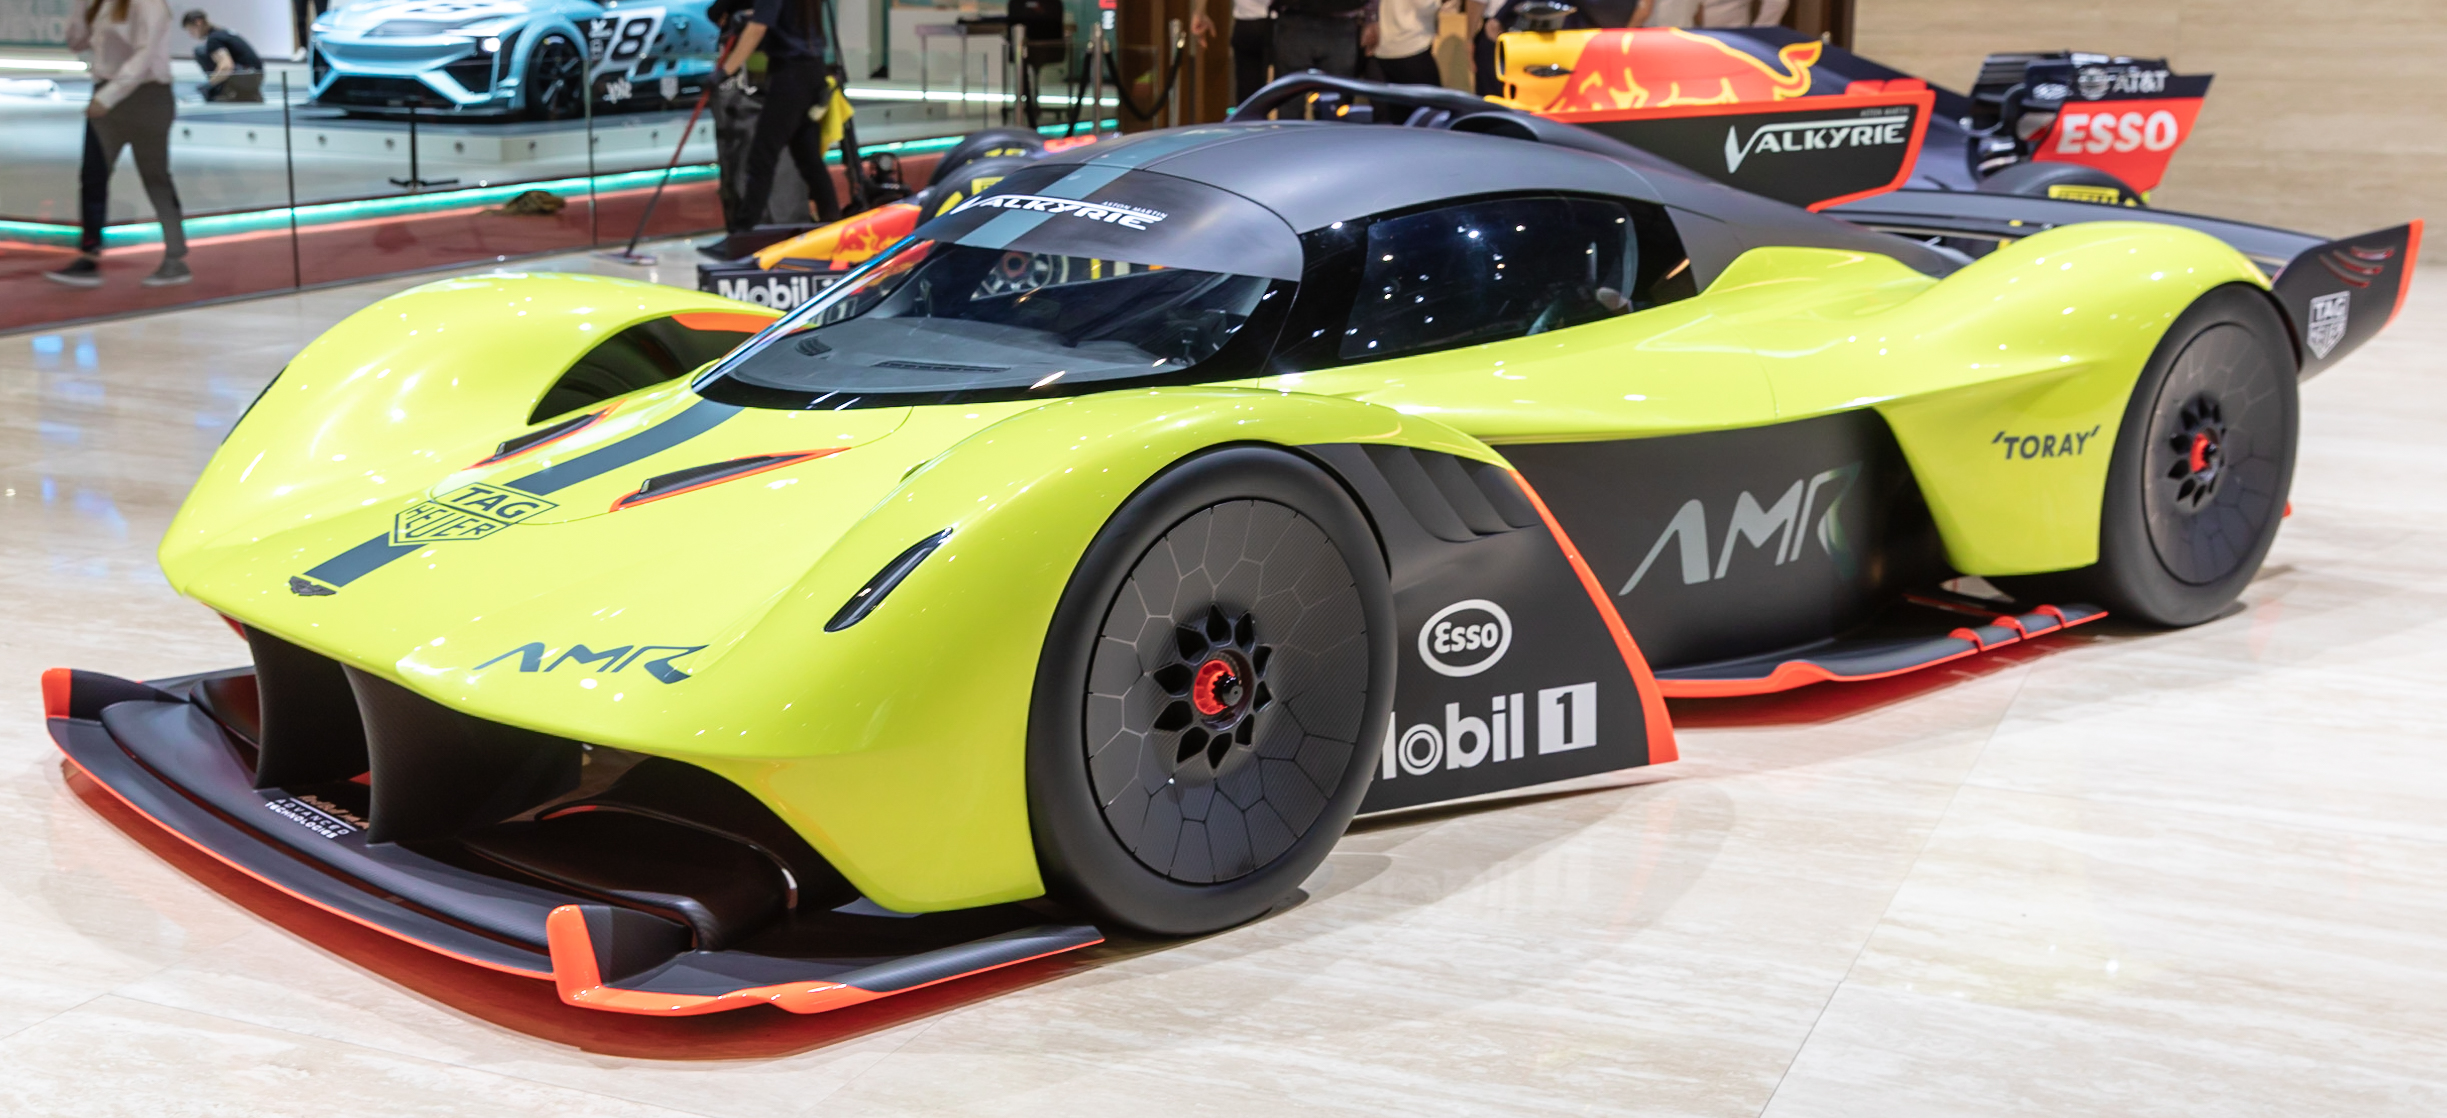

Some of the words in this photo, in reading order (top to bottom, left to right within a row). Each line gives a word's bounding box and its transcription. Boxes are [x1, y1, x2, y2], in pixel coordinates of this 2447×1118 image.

[1724, 115, 1909, 174] VALKYRIE
[2056, 110, 2178, 154] ESSO
[950, 194, 1164, 231] VALKYRIE
[1133, 206, 1168, 219] MARTIN
[717, 277, 808, 310] Mobil
[2313, 297, 2346, 321] TAG
[450, 486, 541, 519] TAG
[405, 504, 497, 539] HEUER
[1618, 461, 1862, 596] AMR
[1434, 621, 1499, 654] Esso
[472, 641, 710, 685] AMR
[264, 801, 338, 839] TECHNOLOGIES
[275, 798, 350, 835] ADVANCED
